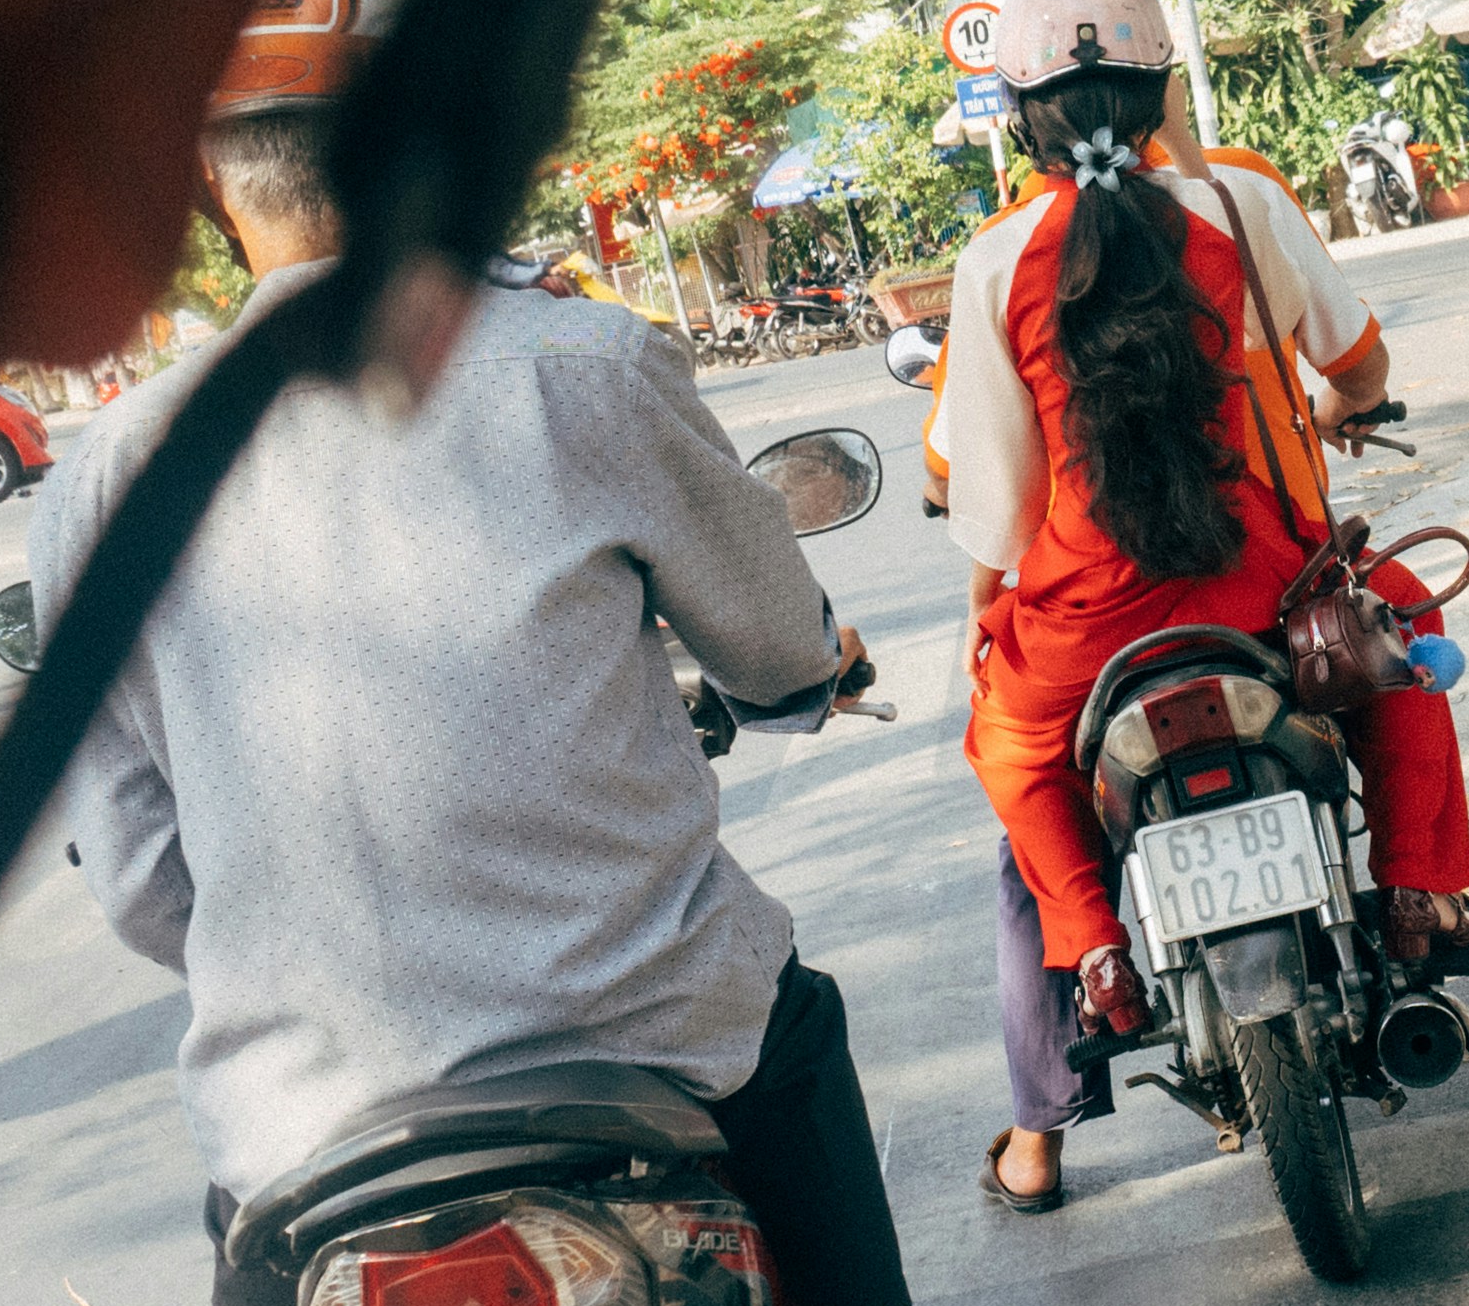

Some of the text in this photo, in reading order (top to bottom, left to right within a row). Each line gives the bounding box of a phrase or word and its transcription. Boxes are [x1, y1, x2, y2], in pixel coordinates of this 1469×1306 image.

[1166, 808, 1287, 874] 63-B9
[1163, 853, 1312, 929] 102.01
[662, 1228, 740, 1262] BLADE
